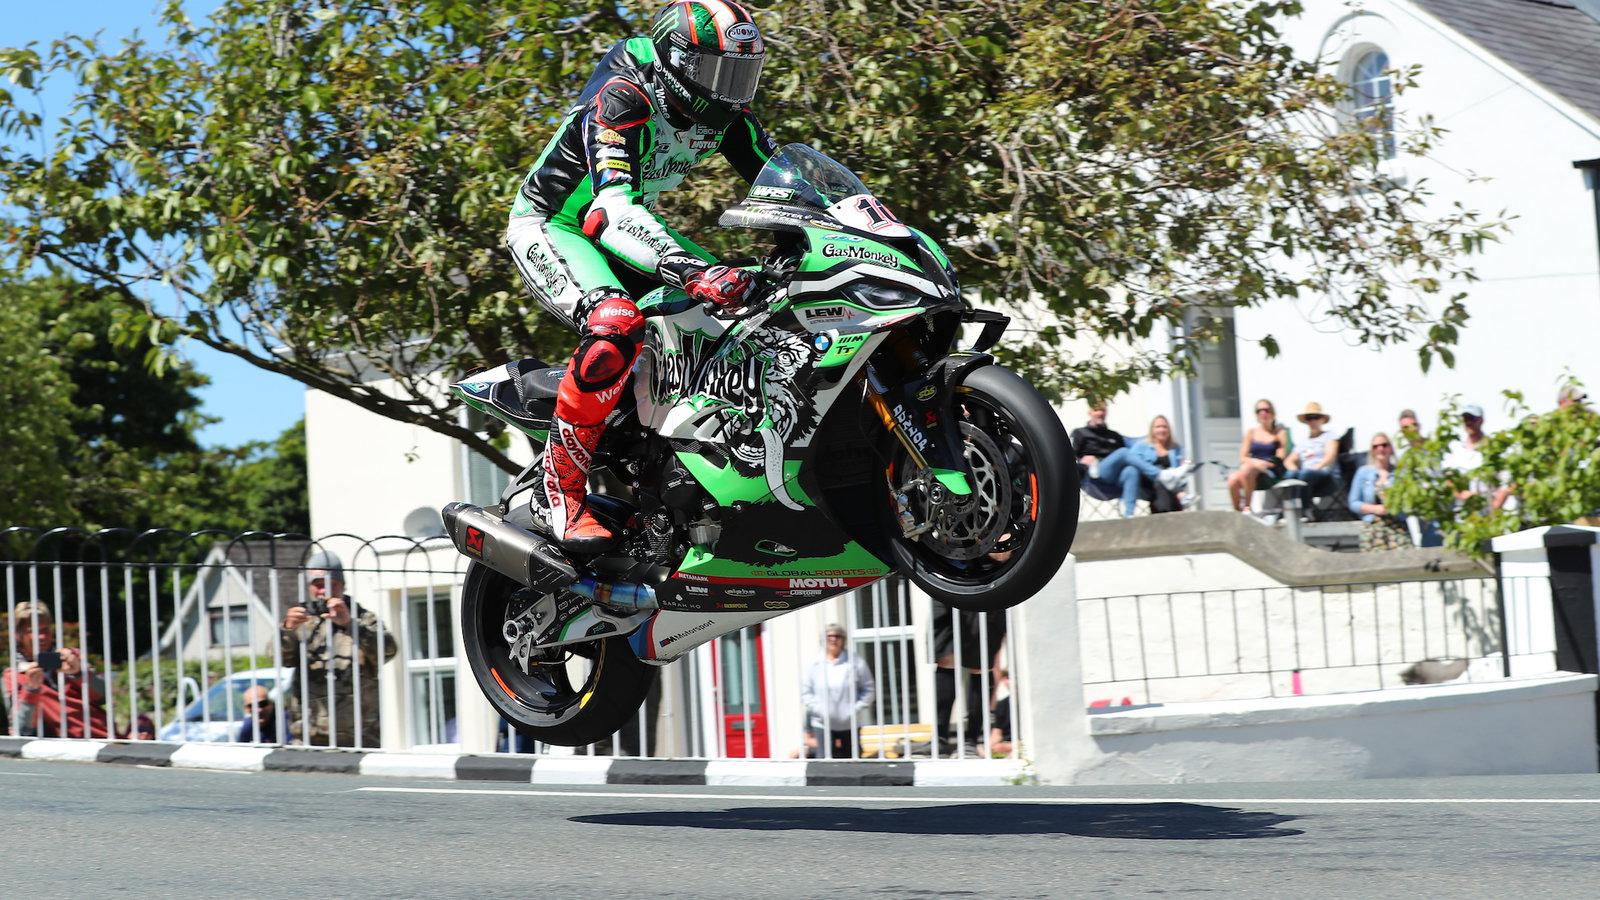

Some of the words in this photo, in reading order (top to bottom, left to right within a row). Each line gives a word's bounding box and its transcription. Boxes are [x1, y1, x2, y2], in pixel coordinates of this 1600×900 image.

[691, 140, 718, 149] MOTUL
[822, 243, 899, 268] GasMonkey
[599, 305, 635, 319] Weise
[805, 306, 843, 319] LEW
[917, 384, 937, 399] sbs
[893, 404, 929, 452] DUNLOP
[789, 578, 848, 588] MOTUL
[676, 619, 715, 640] Motorsport
